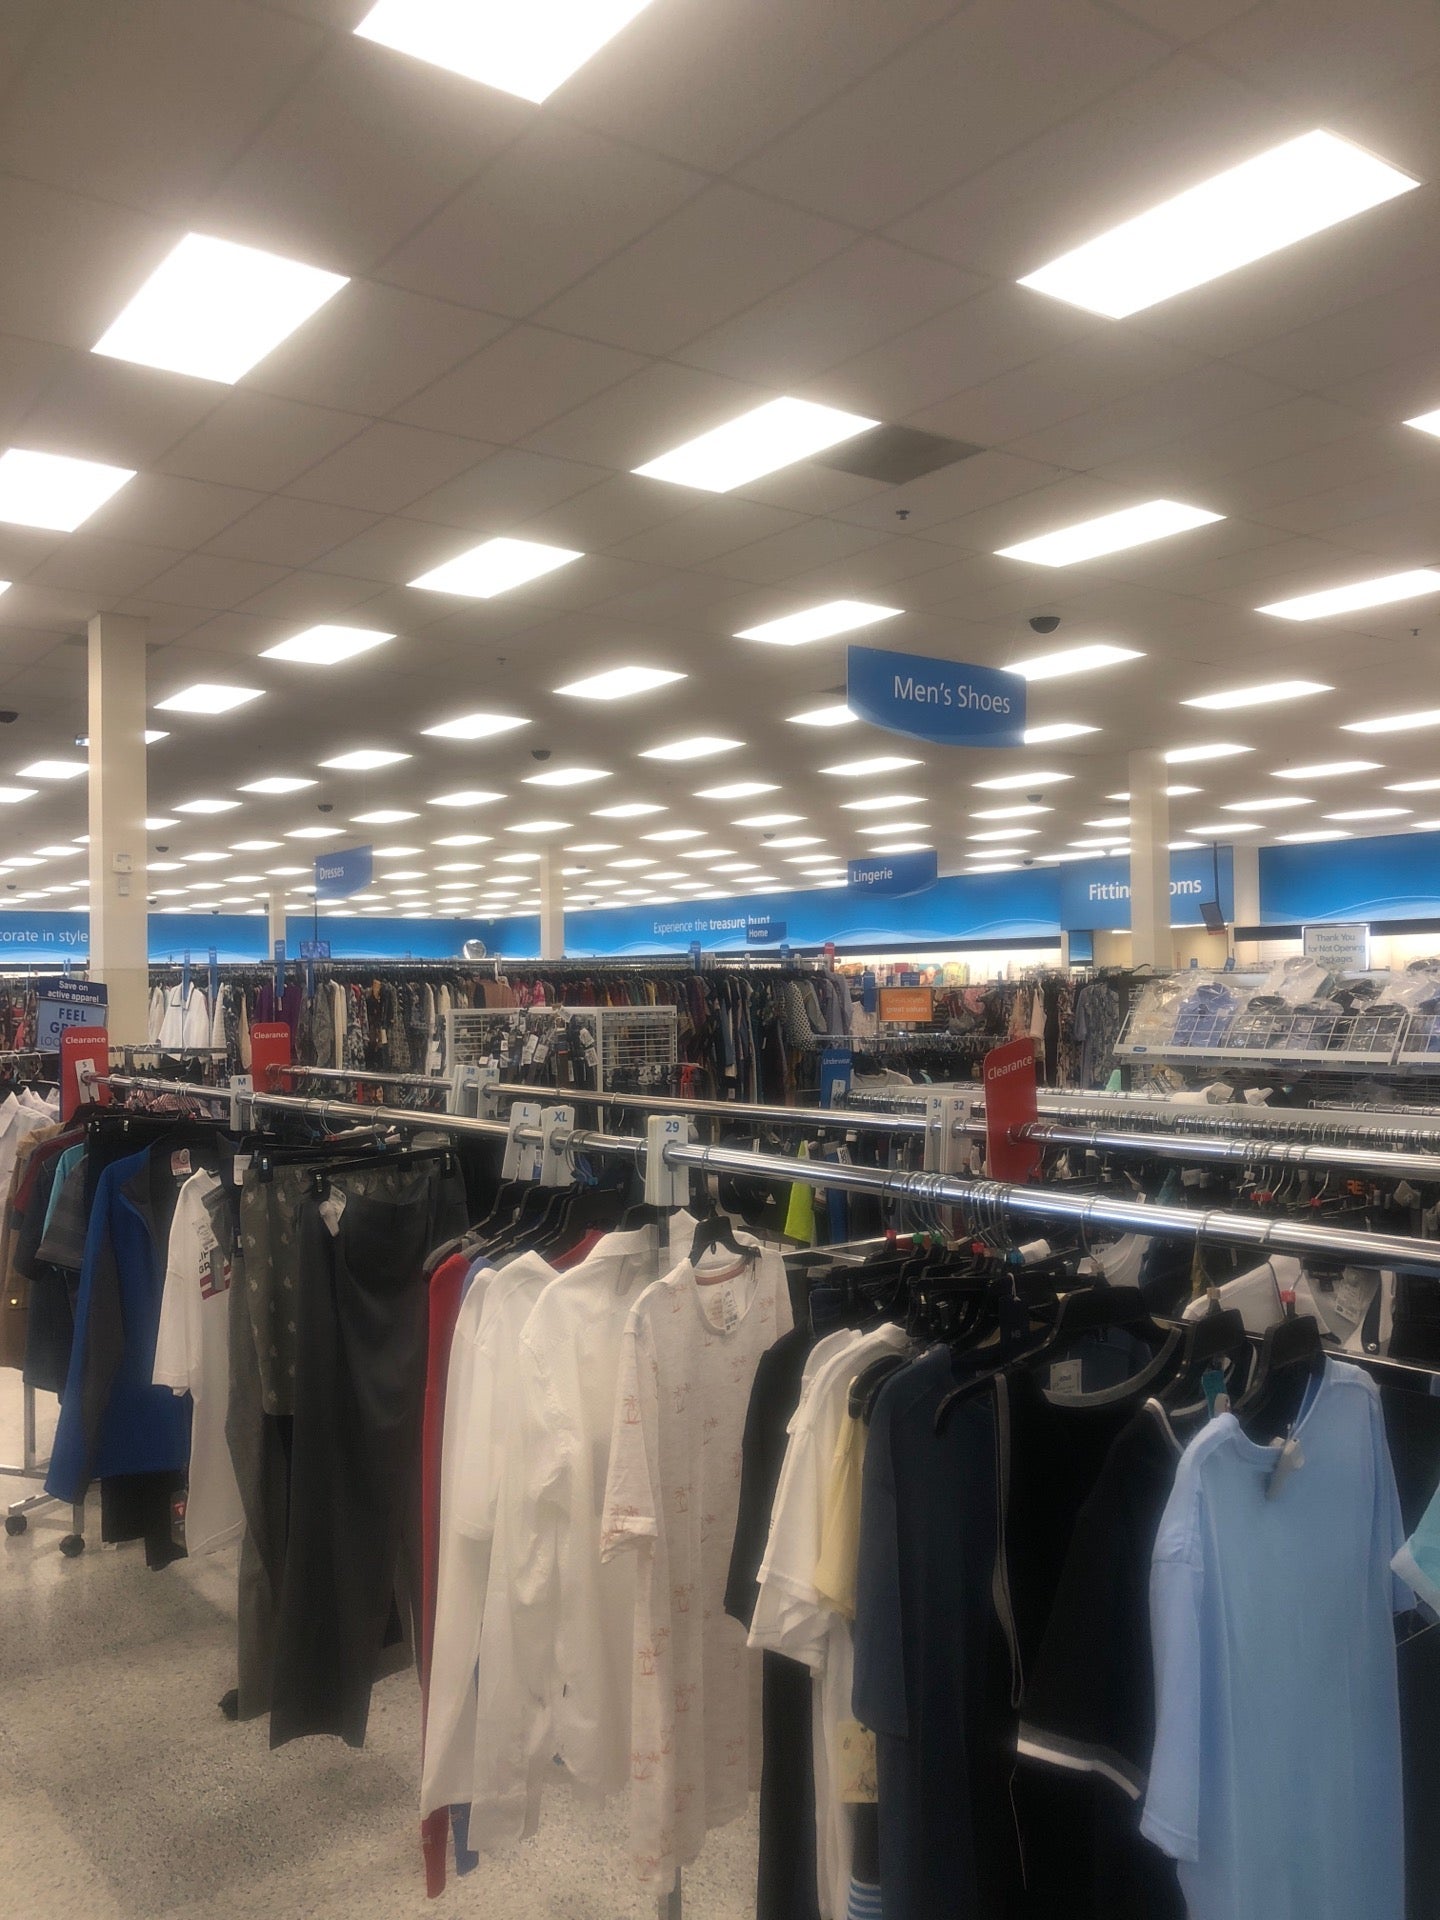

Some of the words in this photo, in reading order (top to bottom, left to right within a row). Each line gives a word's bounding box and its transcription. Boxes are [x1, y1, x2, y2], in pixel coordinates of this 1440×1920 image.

[894, 675, 952, 706] Men's
[958, 685, 1011, 714] Shoes
[319, 866, 345, 880] Dresses
[853, 867, 893, 885] Lingerie
[1089, 881, 1132, 901] Fittin
[653, 921, 693, 935] Experience
[695, 918, 708, 931] the
[709, 918, 746, 930] treasure
[43, 929, 55, 942] in
[59, 929, 89, 946] style
[749, 929, 769, 938] Home
[1316, 934, 1340, 942] Thank
[1341, 933, 1355, 942] You
[1320, 944, 1333, 953] Not
[1333, 944, 1366, 954] Opening
[59, 980, 77, 990] Save
[78, 984, 89, 992] on
[47, 990, 70, 1000] active
[71, 993, 100, 1004] apparel
[58, 1007, 88, 1023] FEEL
[65, 1036, 107, 1045] Clearance
[253, 1031, 289, 1040] Clearance
[987, 1054, 1033, 1081] Clearance
[237, 1078, 247, 1086] M
[522, 1106, 529, 1118] L
[953, 1101, 965, 1111] 32
[554, 1111, 568, 1123] XL
[665, 1121, 680, 1133] 29
